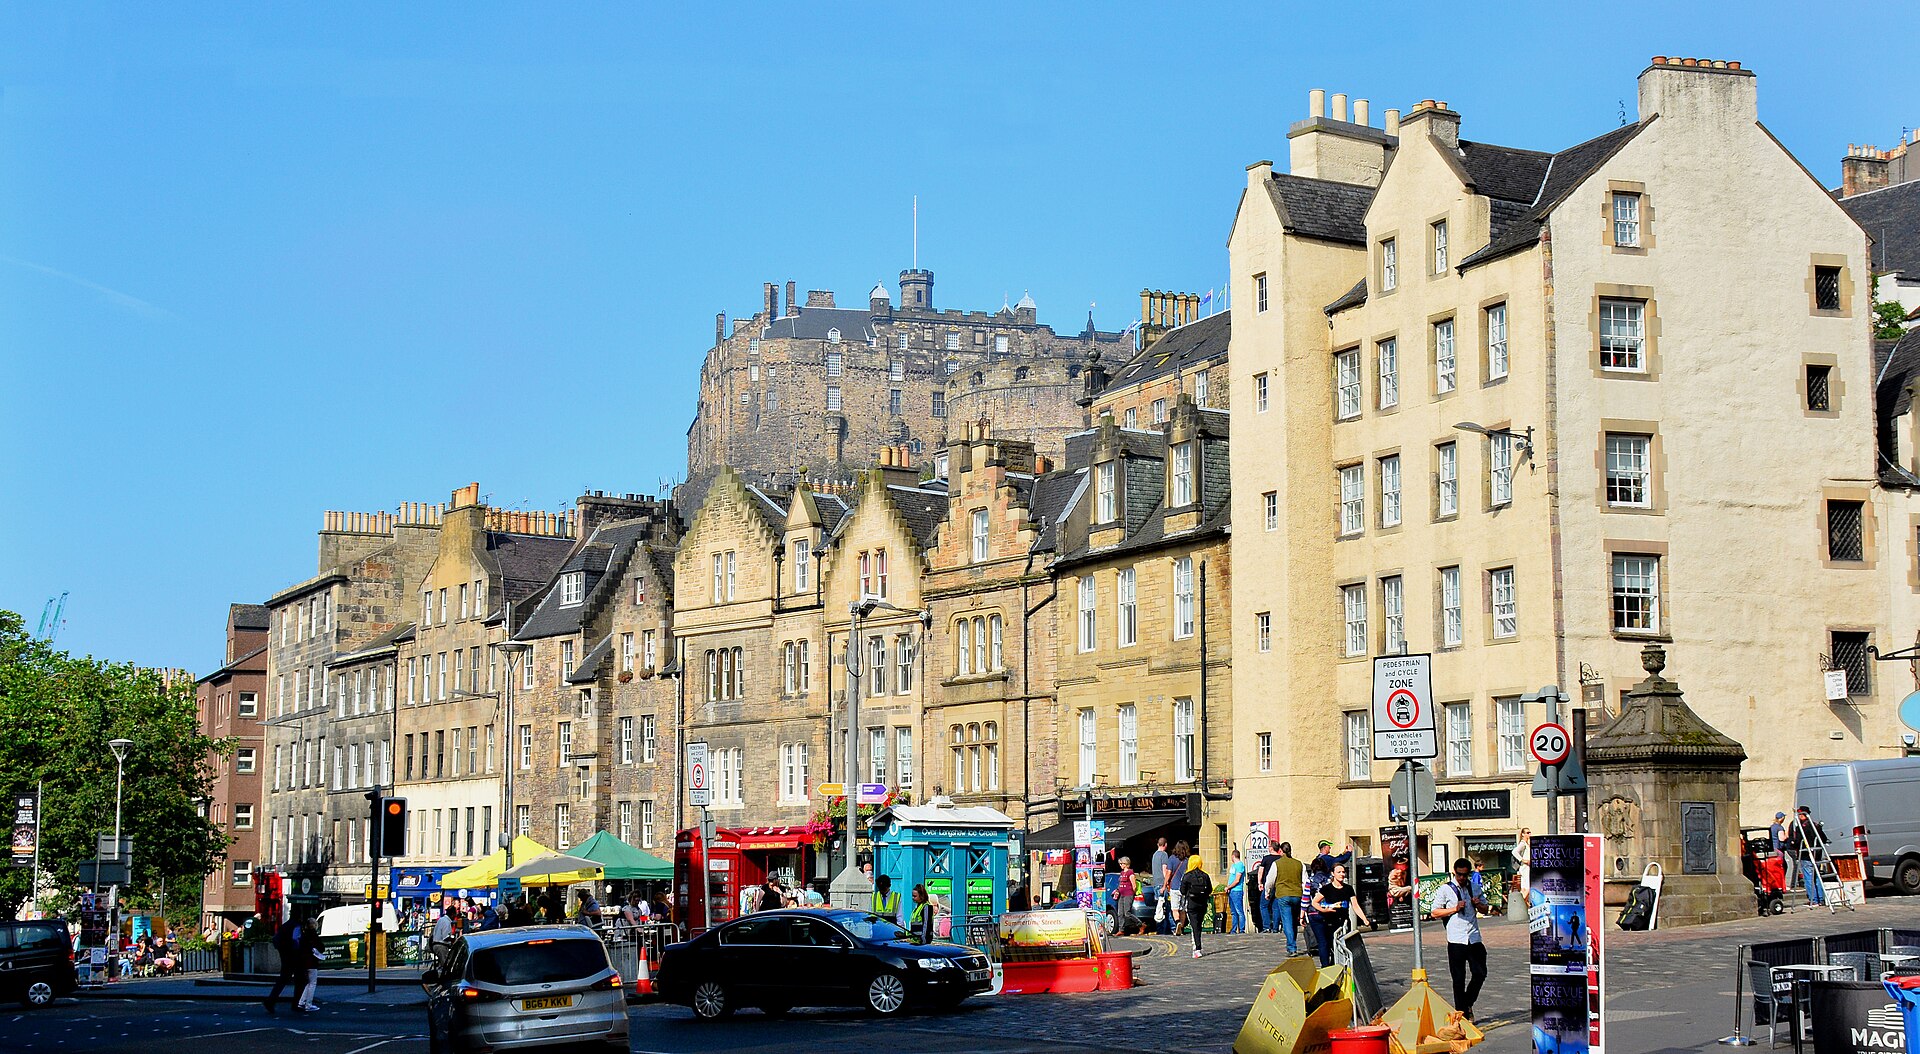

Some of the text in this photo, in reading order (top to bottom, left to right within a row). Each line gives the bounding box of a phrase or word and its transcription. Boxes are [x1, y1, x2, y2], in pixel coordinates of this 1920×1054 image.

[1383, 660, 1421, 669] PEDESTRIAN
[1389, 679, 1414, 688] ZONE
[1536, 735, 1565, 752] 20
[1433, 798, 1500, 812] SMARKET HOTEL
[921, 828, 936, 836] Over
[938, 828, 966, 837] Langshaw
[1252, 837, 1268, 849] 220
[1531, 847, 1581, 860] NEWSREVUE
[777, 867, 795, 876] ALBA
[525, 998, 568, 1009] BG67 KKV
[1258, 1013, 1285, 1046] LITTER
